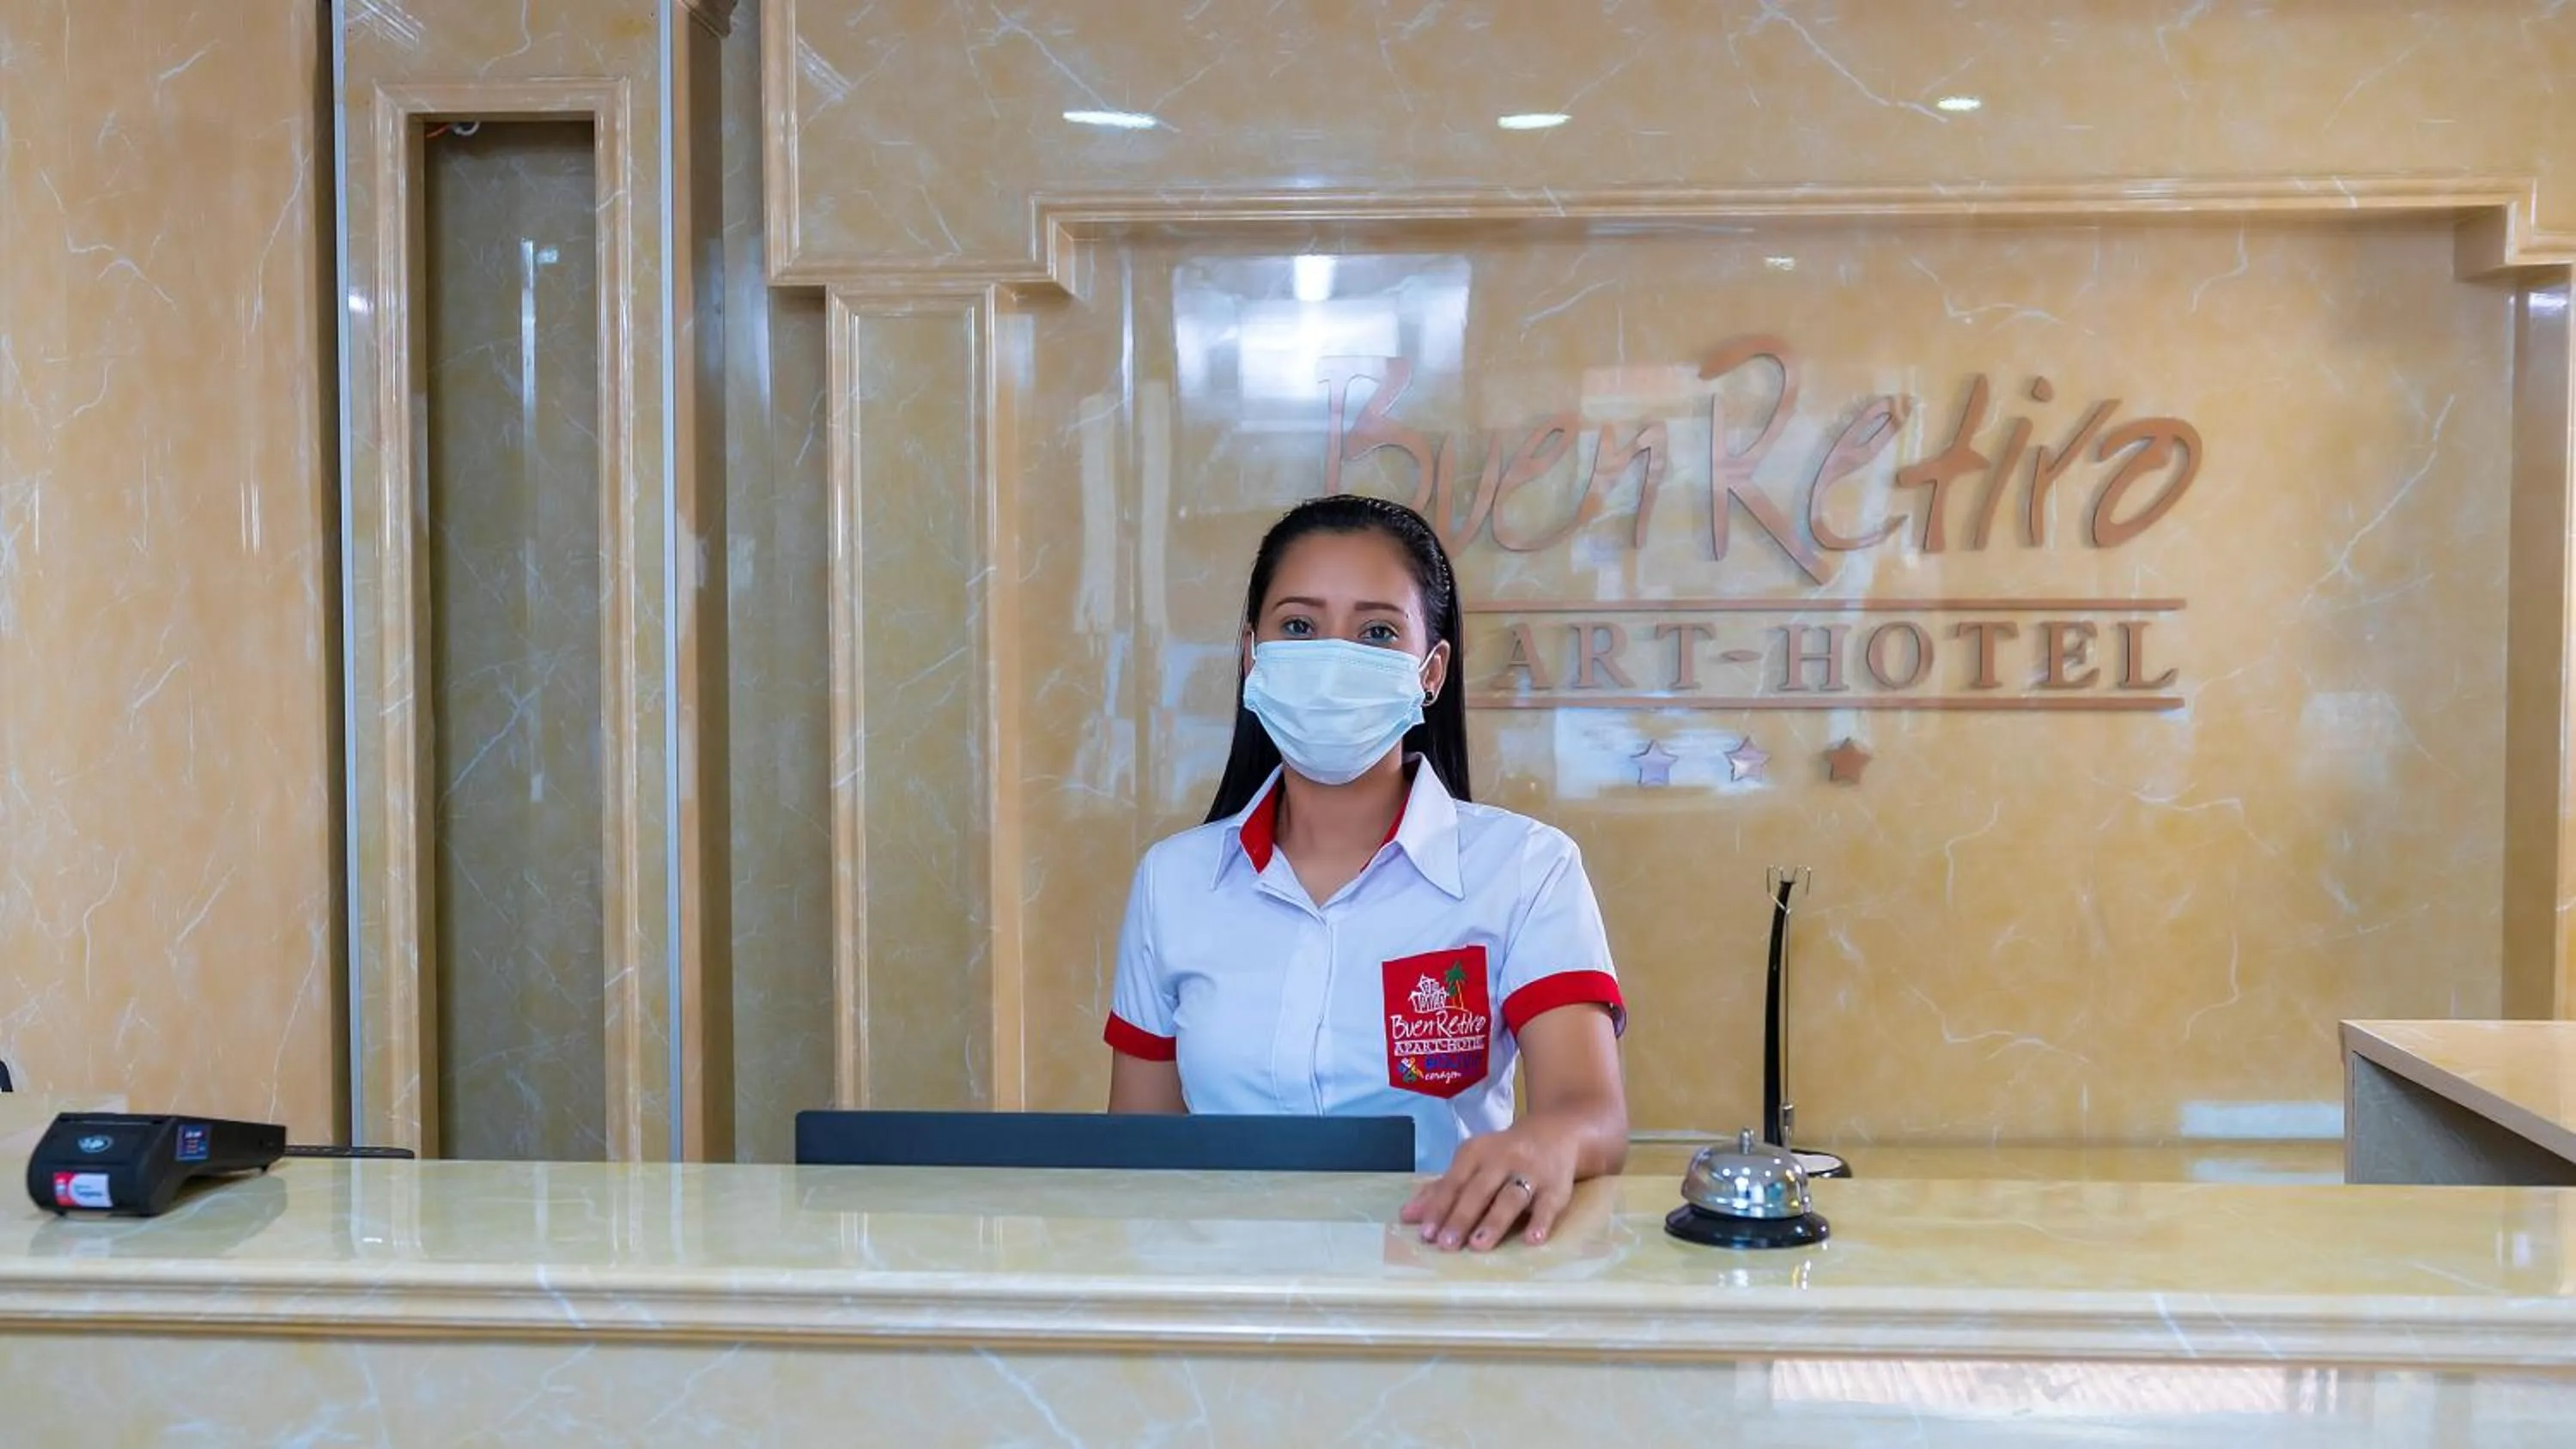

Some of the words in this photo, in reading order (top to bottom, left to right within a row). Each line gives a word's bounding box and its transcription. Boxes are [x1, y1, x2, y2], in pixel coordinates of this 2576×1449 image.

[1317, 355, 1668, 558] Buen
[1698, 334, 2202, 587] Retiro
[1390, 1014, 1433, 1040] Buen
[1436, 1010, 1486, 1037] Retiro
